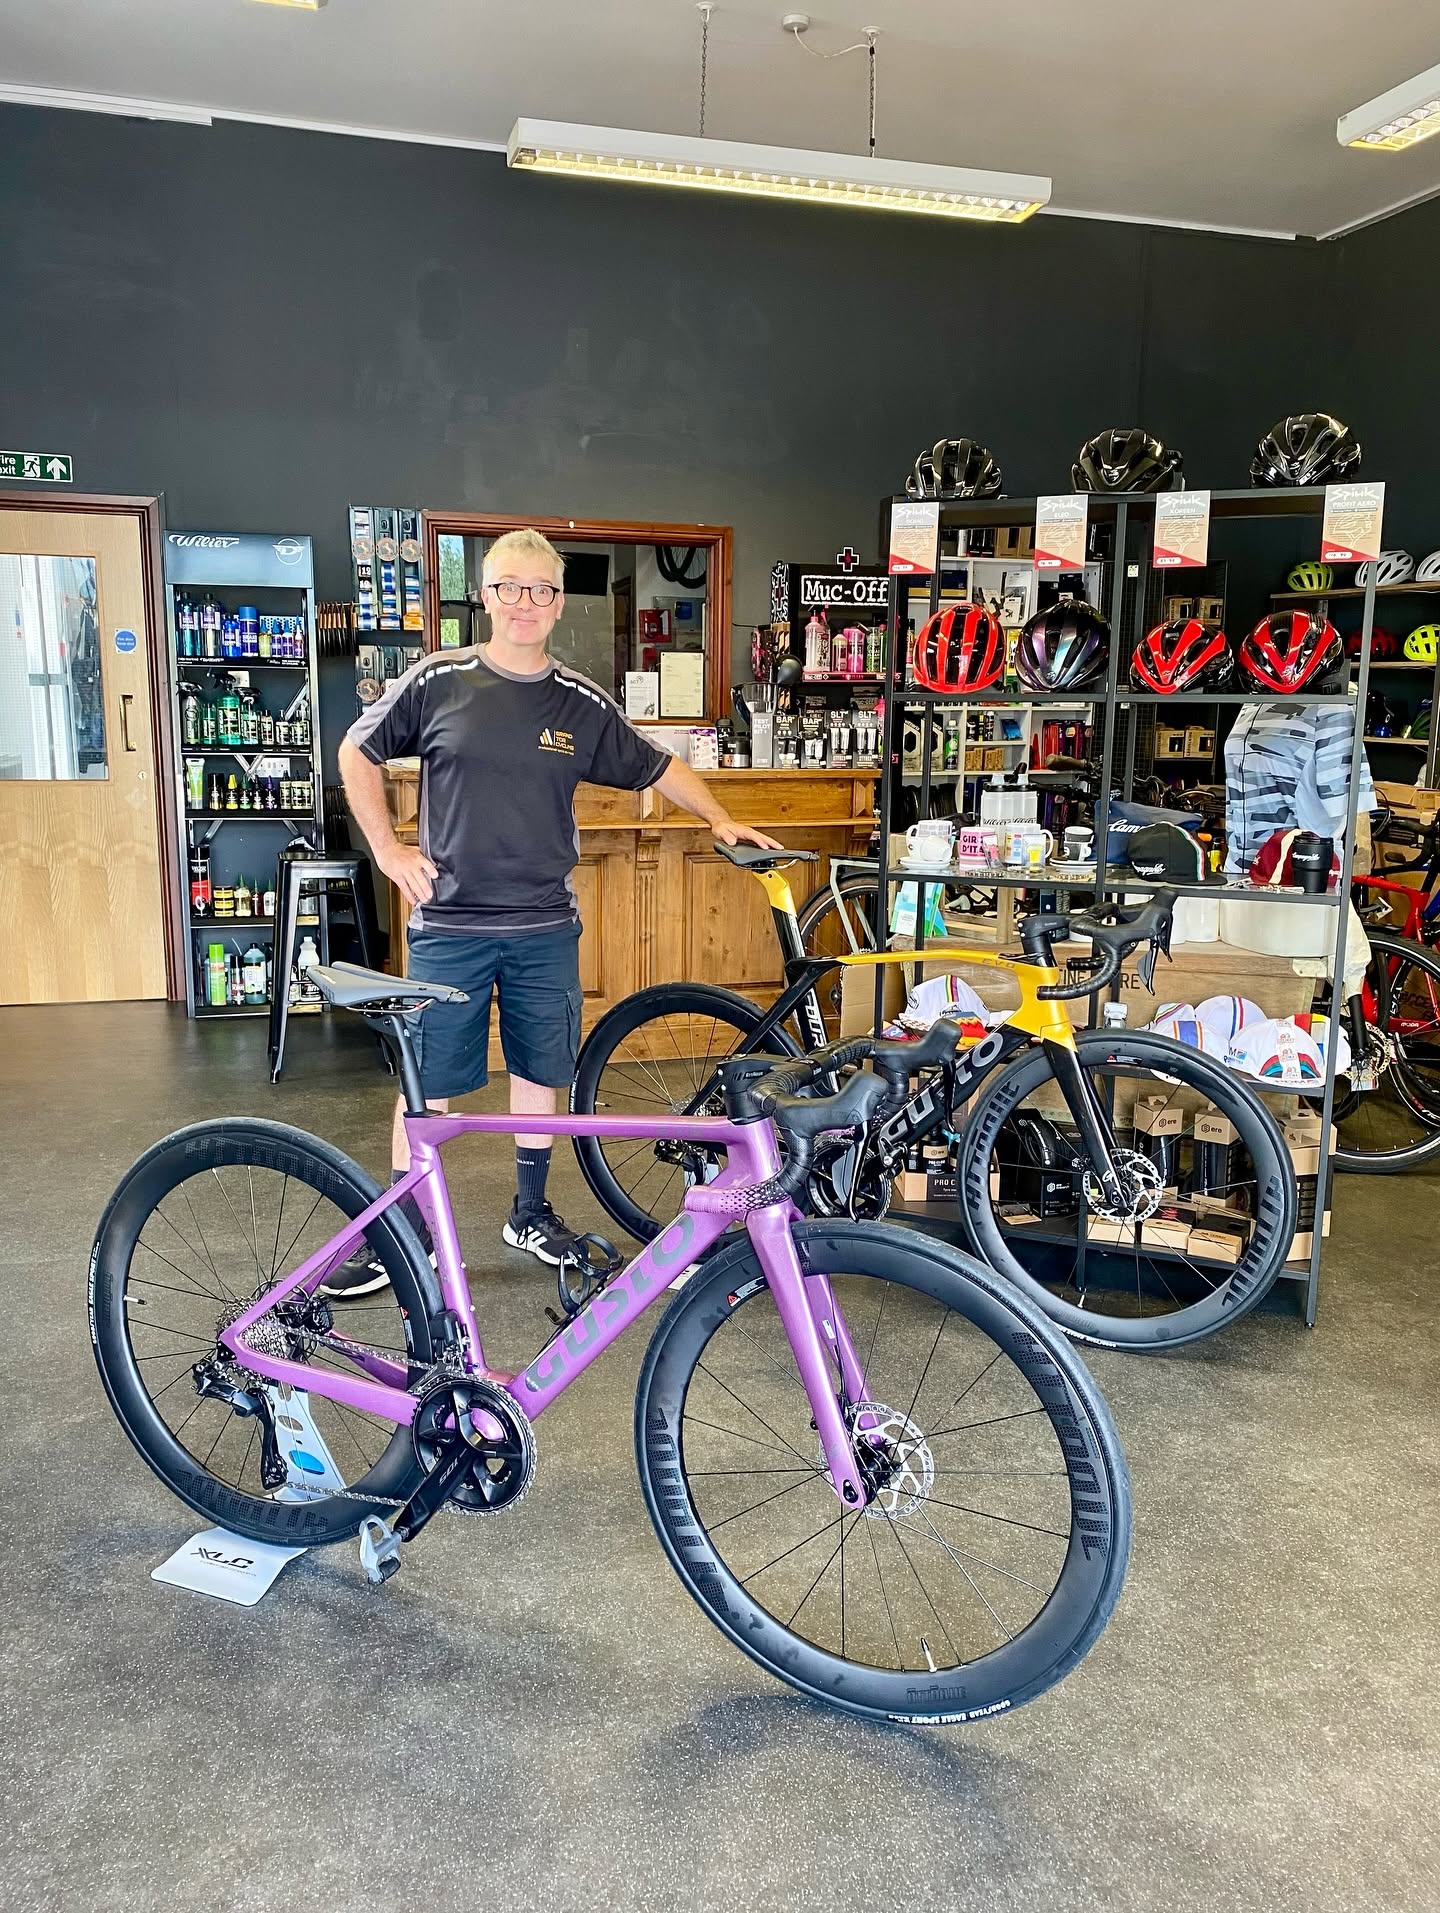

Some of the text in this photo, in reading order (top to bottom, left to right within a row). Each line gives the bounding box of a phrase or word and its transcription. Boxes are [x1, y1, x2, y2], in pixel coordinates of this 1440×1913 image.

[1159, 493, 1206, 509] Spiuk
[1328, 486, 1381, 502] Spiuk
[895, 505, 936, 519] Spiuk
[1039, 498, 1084, 513] Spiuk
[168, 534, 240, 548] Wilier
[805, 580, 888, 602] Muc-Off
[1057, 968, 1088, 986] INE
[878, 1032, 1005, 1146] GUTO
[1211, 1126, 1223, 1134] ere
[525, 1213, 696, 1393] GUSTO
[189, 1546, 255, 1569] XLC
[968, 1698, 1012, 1719] GOODYEAR
[911, 1715, 940, 1724] SPORT
[940, 1712, 967, 1723] EAGLE
